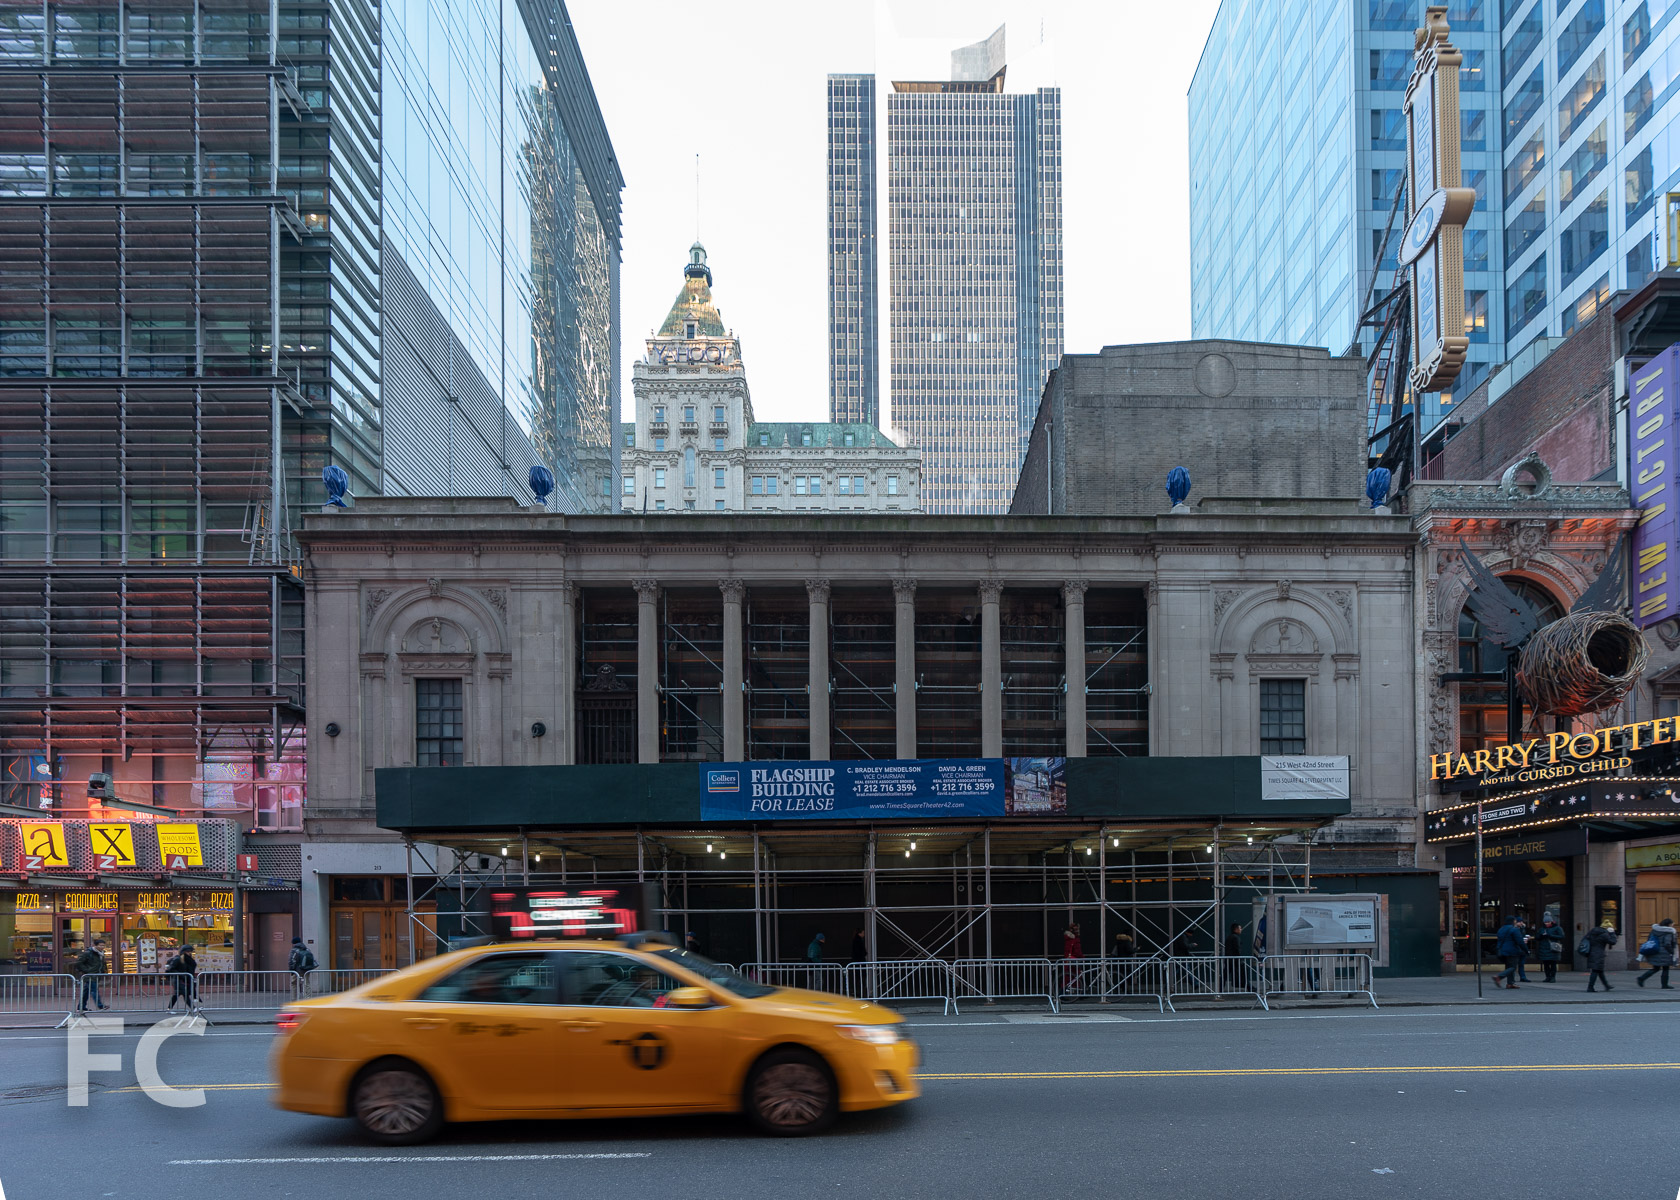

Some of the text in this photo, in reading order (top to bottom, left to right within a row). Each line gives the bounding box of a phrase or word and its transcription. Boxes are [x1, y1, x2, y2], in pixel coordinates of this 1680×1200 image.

[1416, 95, 1431, 198] THEATRE
[1420, 267, 1434, 341] LYRIC
[653, 345, 727, 364] YAHOO!
[1636, 366, 1667, 619] NEW VICTORY
[1429, 737, 1541, 781] HARRY
[711, 774, 736, 782] Colliers
[751, 768, 835, 783] FLAGSHIP
[1479, 757, 1632, 786] AND THE CURSED CHILD
[752, 782, 835, 797] BUILDING
[880, 784, 894, 792] 716
[896, 783, 917, 791] 3596
[942, 783, 956, 791] 212
[958, 783, 972, 791] 716
[974, 783, 995, 791] 3599
[750, 798, 835, 812] FOR LEASE
[869, 802, 964, 810] www.TimesSquareTheater42.com
[163, 846, 199, 855] FOODS
[1504, 841, 1546, 856] THEATRE
[16, 893, 40, 909] PIZZA
[65, 893, 118, 909] SANDWICHES
[138, 892, 170, 909] SALADS
[211, 892, 234, 909] PIZZA
[209, 933, 223, 942] Pax
